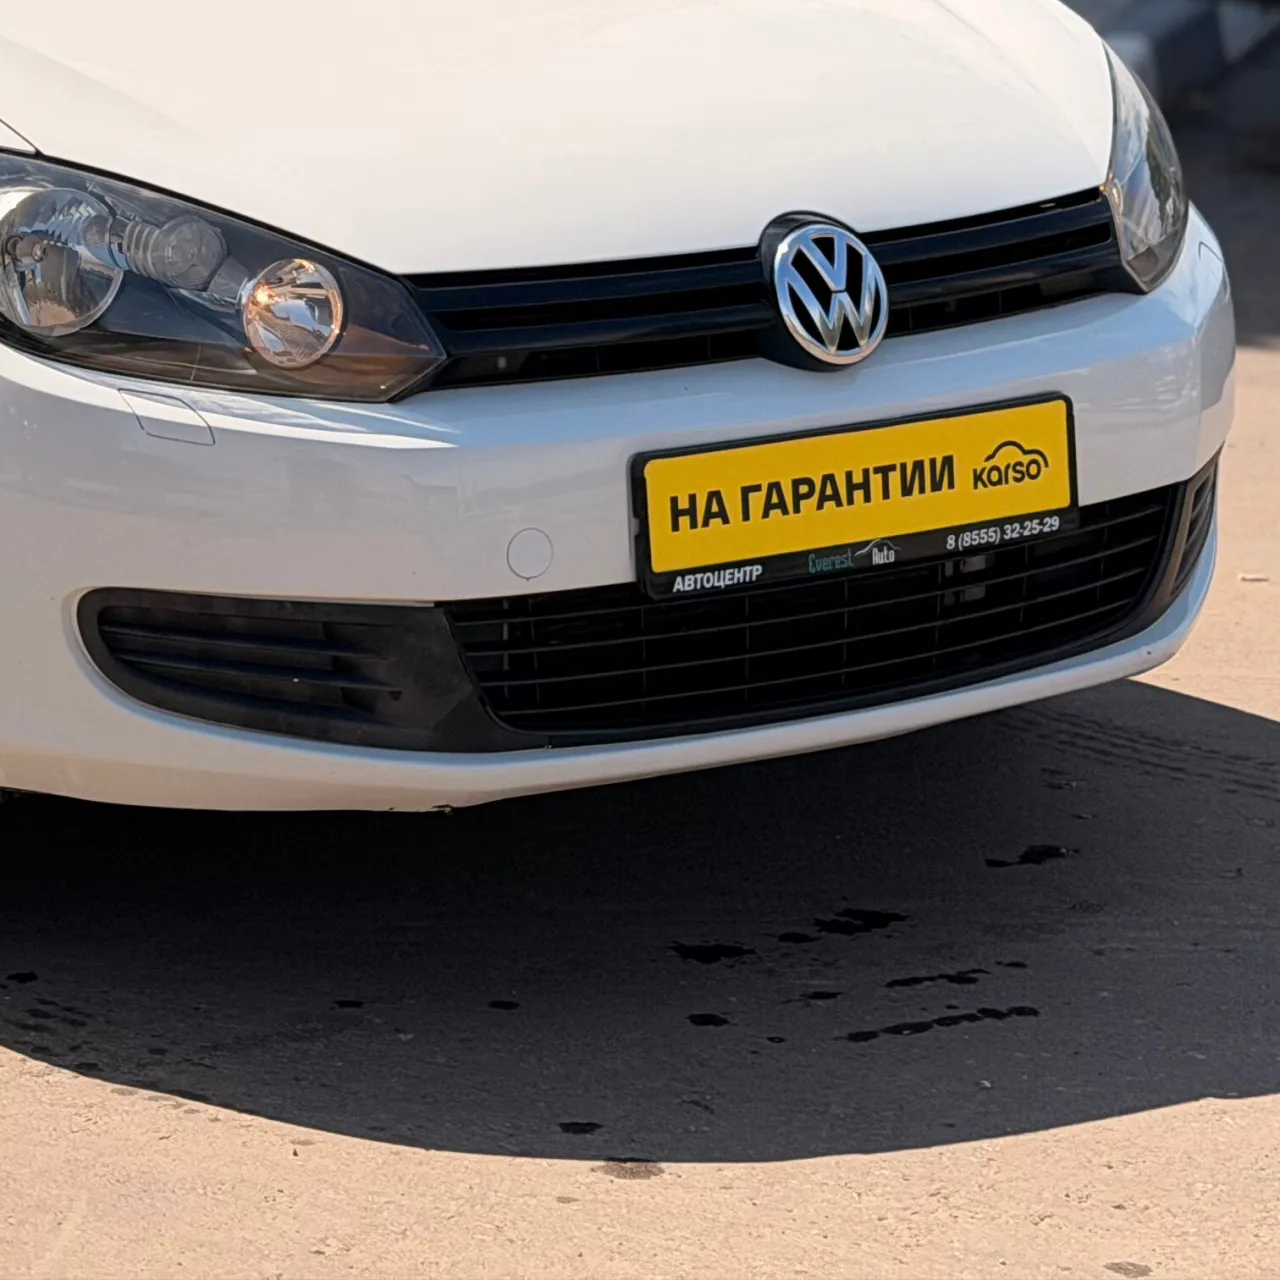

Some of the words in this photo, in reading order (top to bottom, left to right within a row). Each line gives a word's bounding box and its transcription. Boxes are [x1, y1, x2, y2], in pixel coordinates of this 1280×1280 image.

[669, 489, 731, 533] НА
[740, 454, 956, 522] ГАРАНТИИ
[946, 534, 956, 550] 8
[958, 526, 1001, 551] (8555)
[1003, 515, 1060, 540] 32-25-29
[808, 548, 854, 574] Everest
[872, 547, 896, 566] Auto
[672, 565, 763, 593] АВТОЦЕНТР
